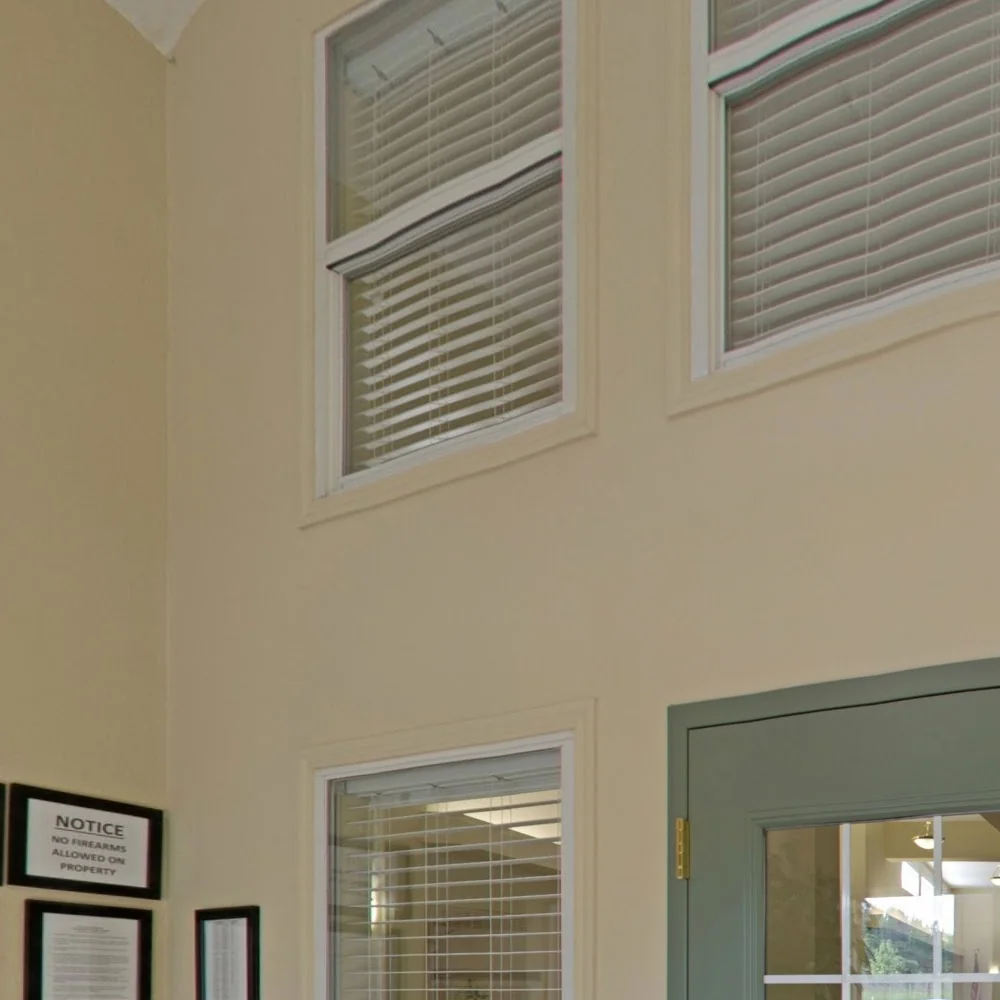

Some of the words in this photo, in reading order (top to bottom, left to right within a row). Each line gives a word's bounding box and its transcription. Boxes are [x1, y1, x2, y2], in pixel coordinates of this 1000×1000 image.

[56, 815, 124, 837] NOTICE
[51, 836, 69, 845] NO
[72, 838, 127, 853] FIREARMS
[51, 848, 106, 862] ALLOWED
[108, 856, 125, 865] ON
[60, 862, 117, 876] PROPERTY
